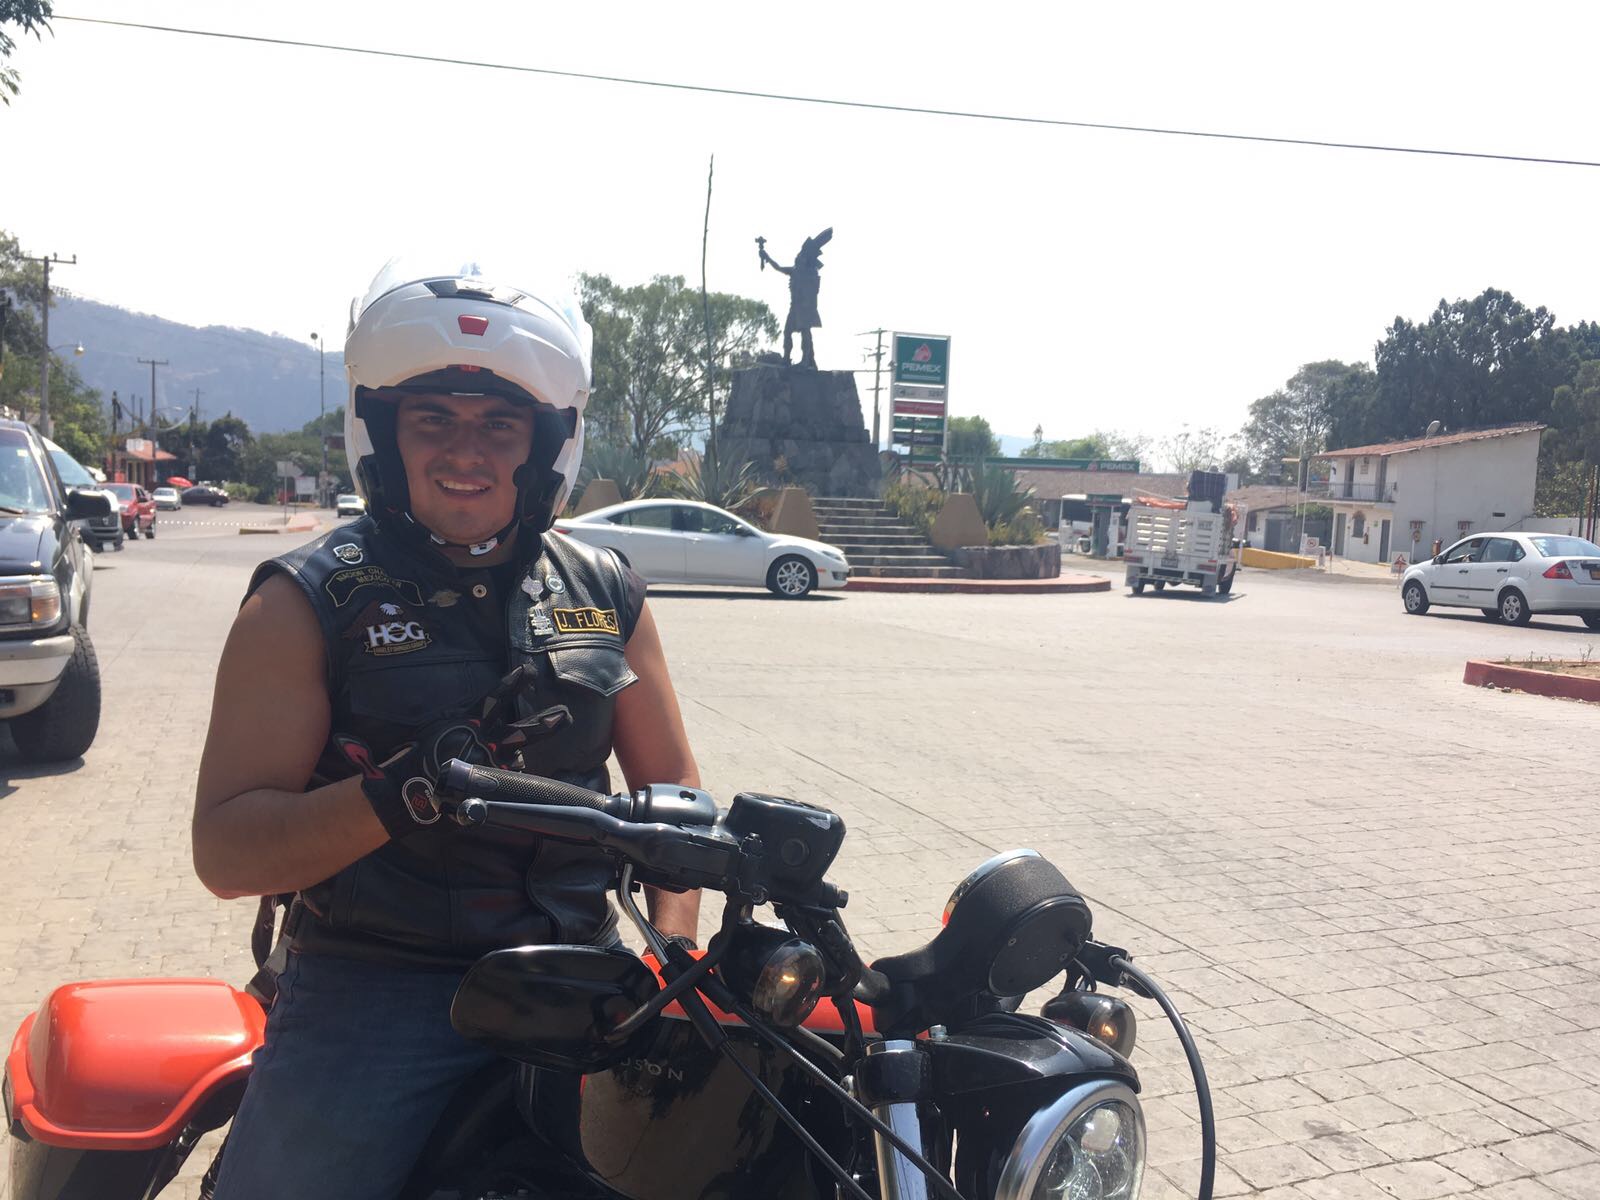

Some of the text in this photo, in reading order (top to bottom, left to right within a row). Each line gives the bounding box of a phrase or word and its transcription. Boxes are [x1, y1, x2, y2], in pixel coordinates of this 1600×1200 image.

[901, 362, 942, 373] PEMEX
[1100, 462, 1135, 471] PEMEX
[576, 611, 616, 630] FLORES
